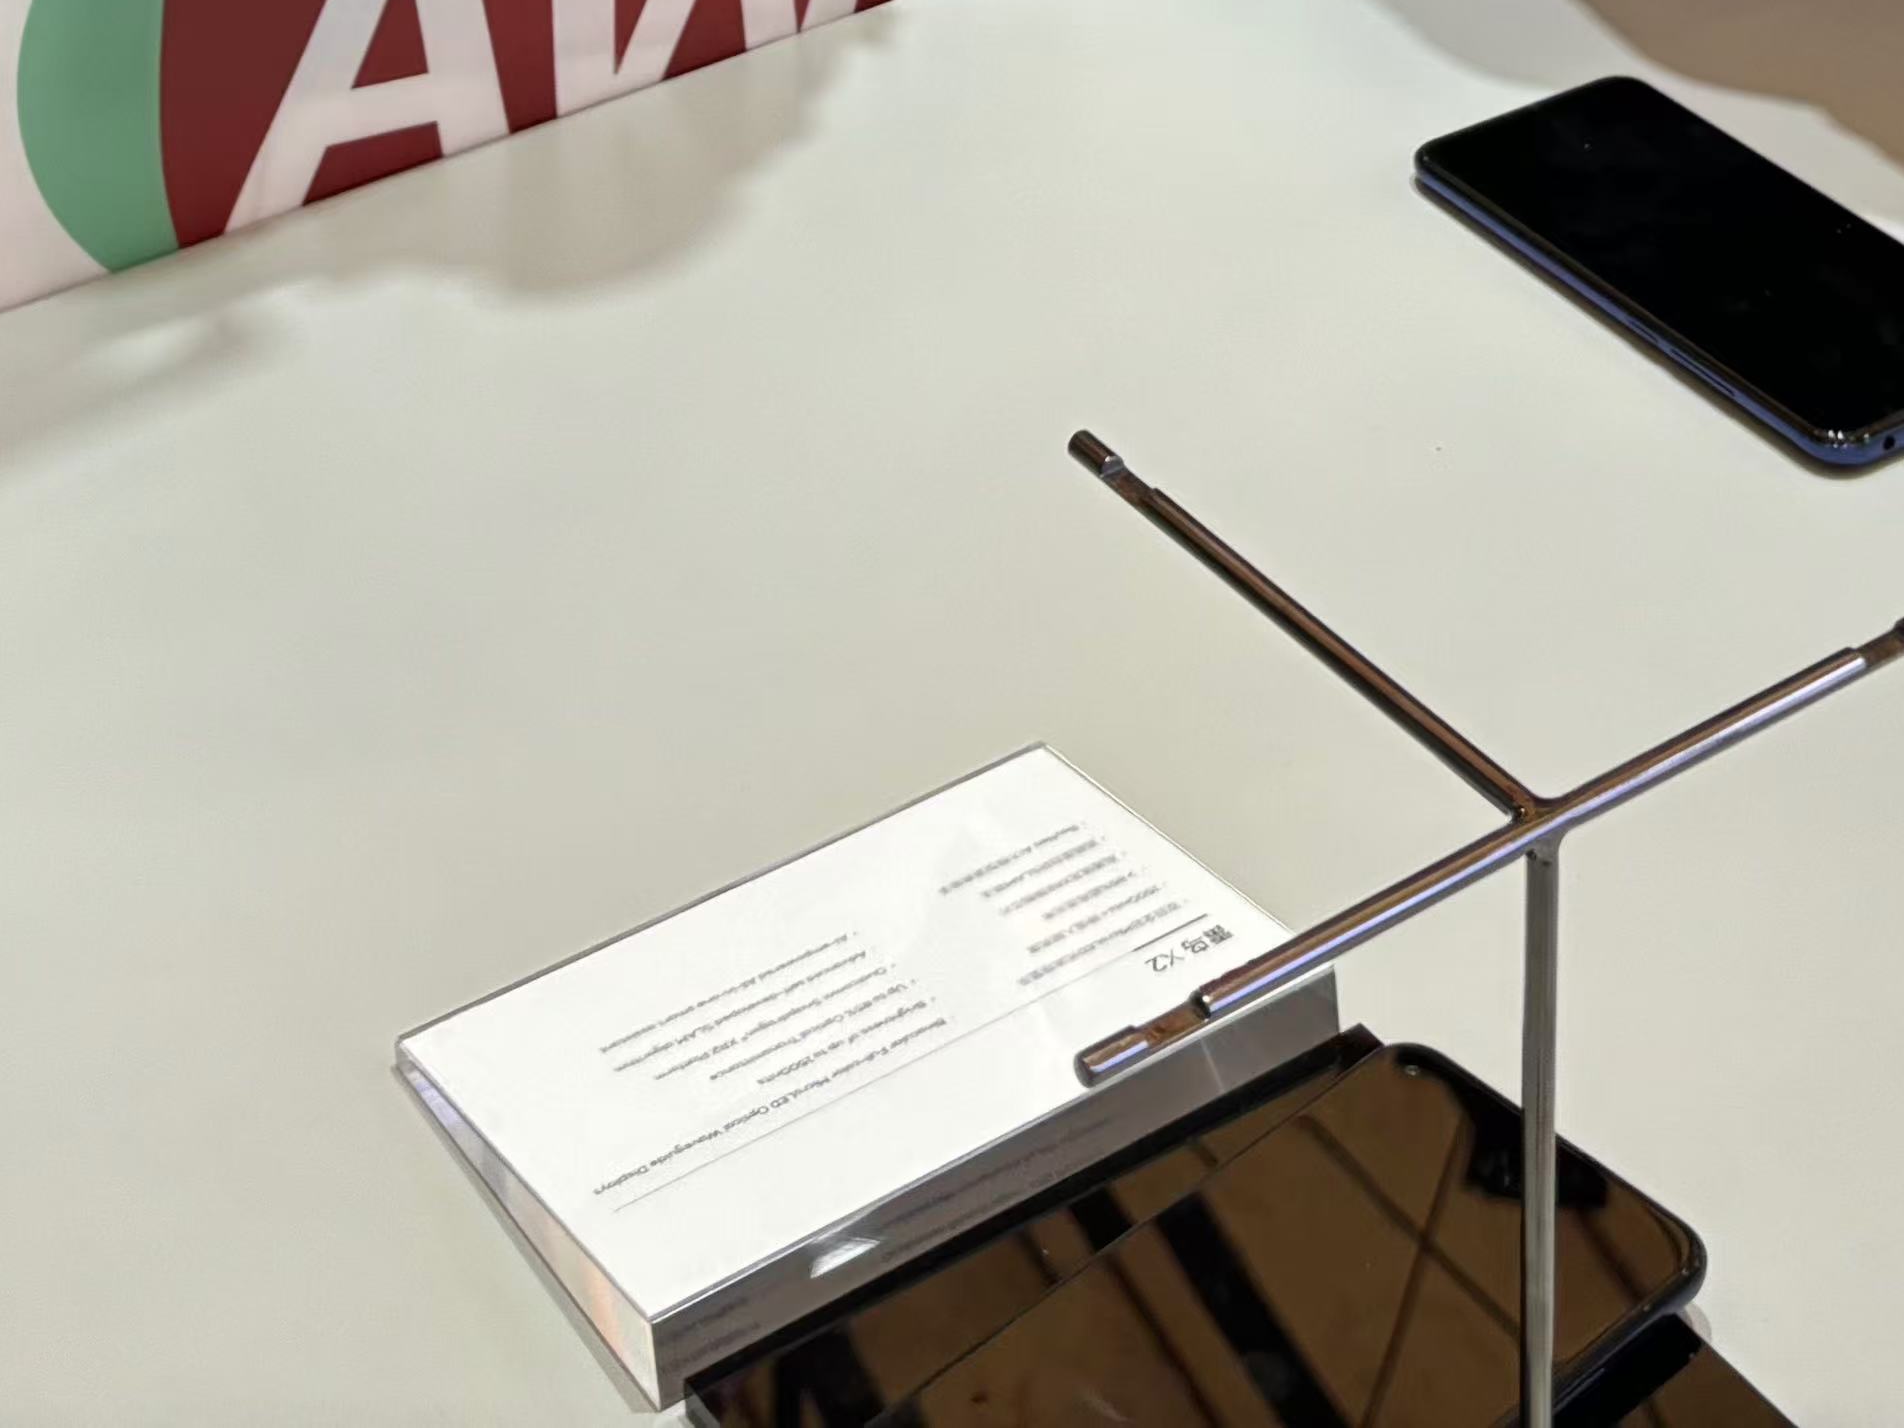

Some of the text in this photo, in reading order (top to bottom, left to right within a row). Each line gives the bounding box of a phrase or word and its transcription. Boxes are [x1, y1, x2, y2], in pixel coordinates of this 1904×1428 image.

[1141, 946, 1187, 974] X2
[767, 1075, 831, 1110] MicroLED
[719, 1103, 771, 1132] Optical
[644, 1125, 724, 1169] Waveguide
[590, 1163, 651, 1197] Displays
